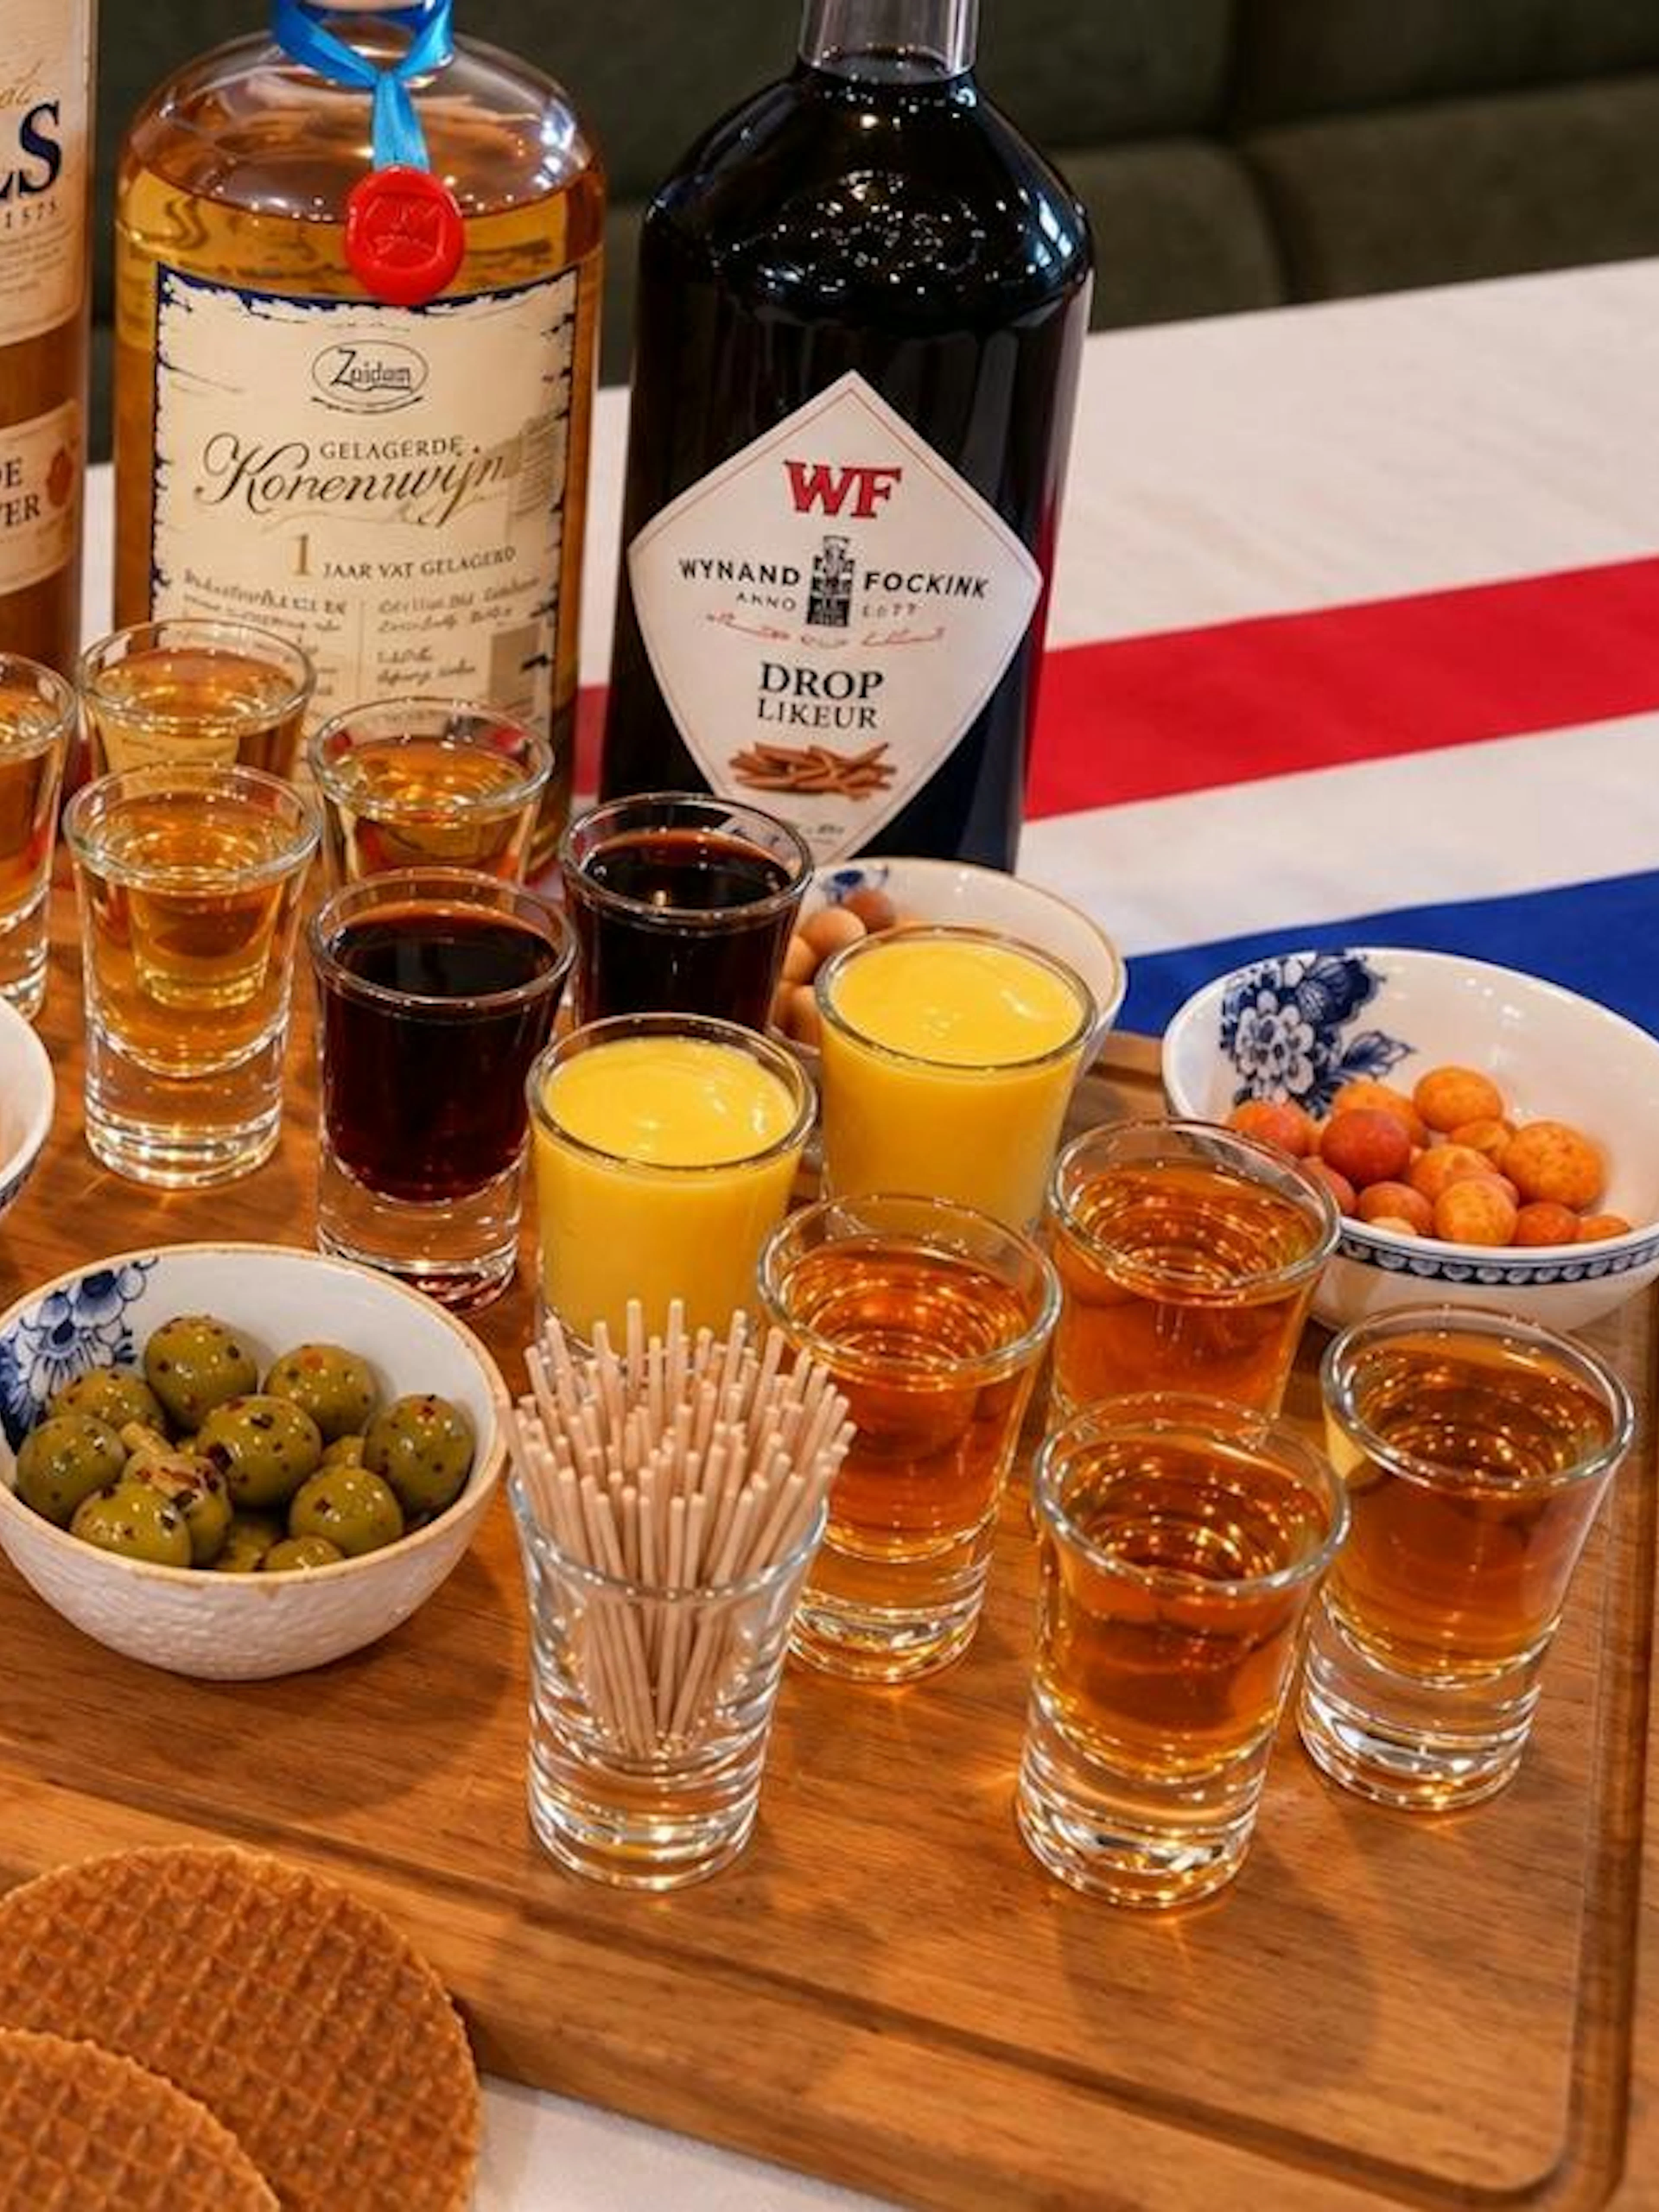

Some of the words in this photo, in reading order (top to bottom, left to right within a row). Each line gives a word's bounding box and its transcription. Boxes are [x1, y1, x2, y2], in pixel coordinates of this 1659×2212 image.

[0, 98, 61, 199] S
[330, 348, 410, 391] Zuidam
[320, 436, 463, 461] GELAGERDE
[783, 459, 902, 518] WF
[292, 533, 310, 576] 1
[322, 563, 372, 579] JAAR
[379, 562, 413, 578] VAT
[420, 546, 516, 575] GELAGERD
[678, 559, 801, 585] WYNAND
[864, 571, 989, 599] FOCKINK
[735, 591, 798, 611] ANNO
[760, 662, 884, 700] DROP
[757, 697, 878, 729] LIKEUR
